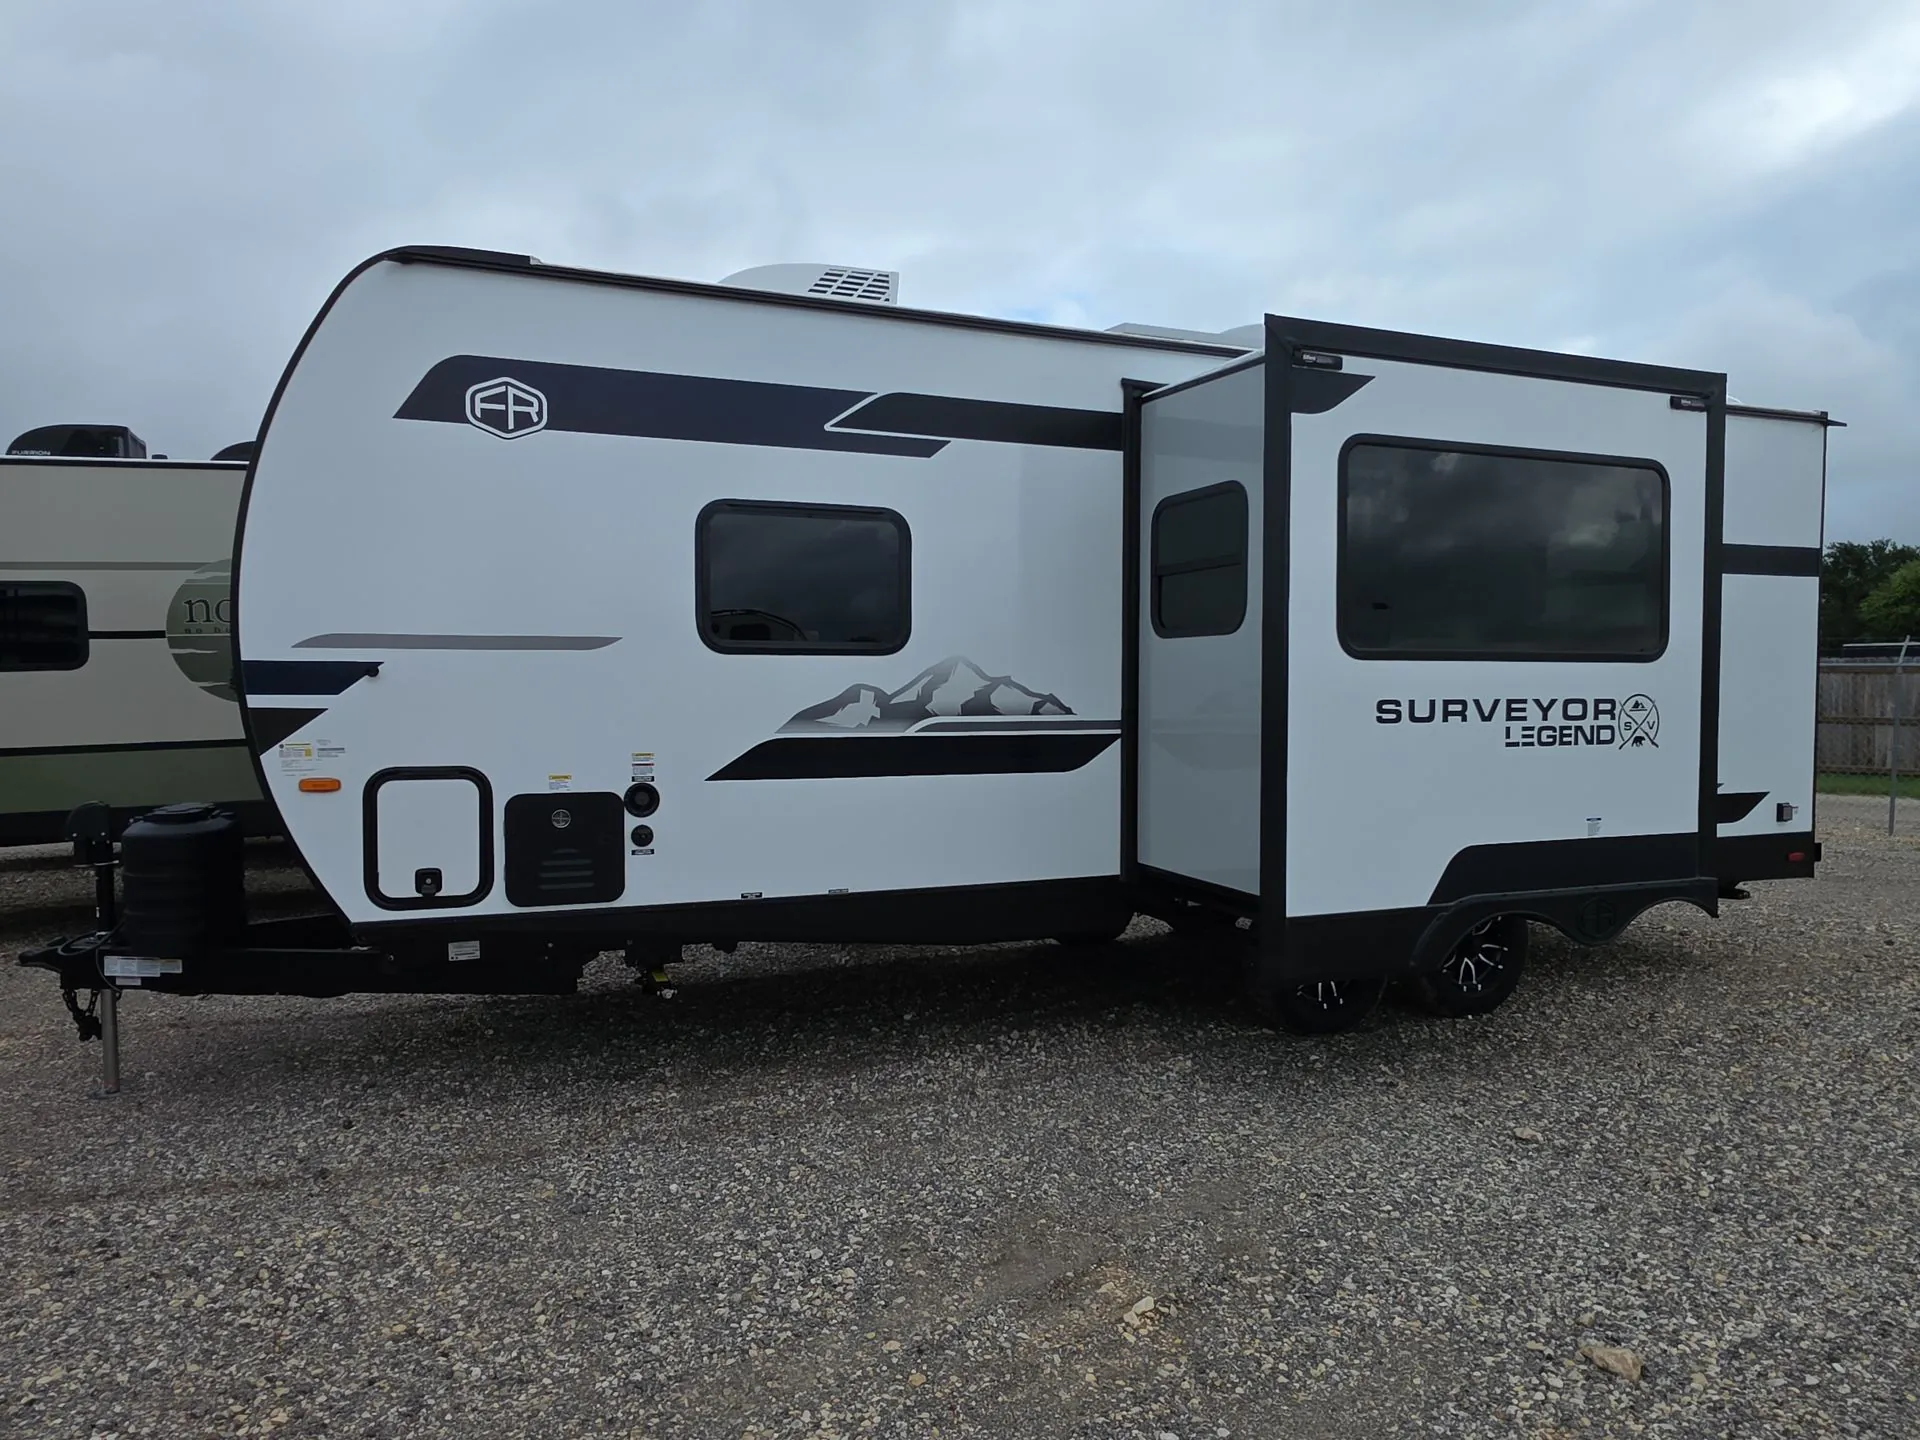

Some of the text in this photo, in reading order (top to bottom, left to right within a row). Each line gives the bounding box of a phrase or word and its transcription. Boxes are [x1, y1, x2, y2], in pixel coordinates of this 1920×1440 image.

[1376, 698, 1617, 723] SURVEYOR
[1505, 725, 1616, 747] LEGEND
[1624, 720, 1656, 731] S V
